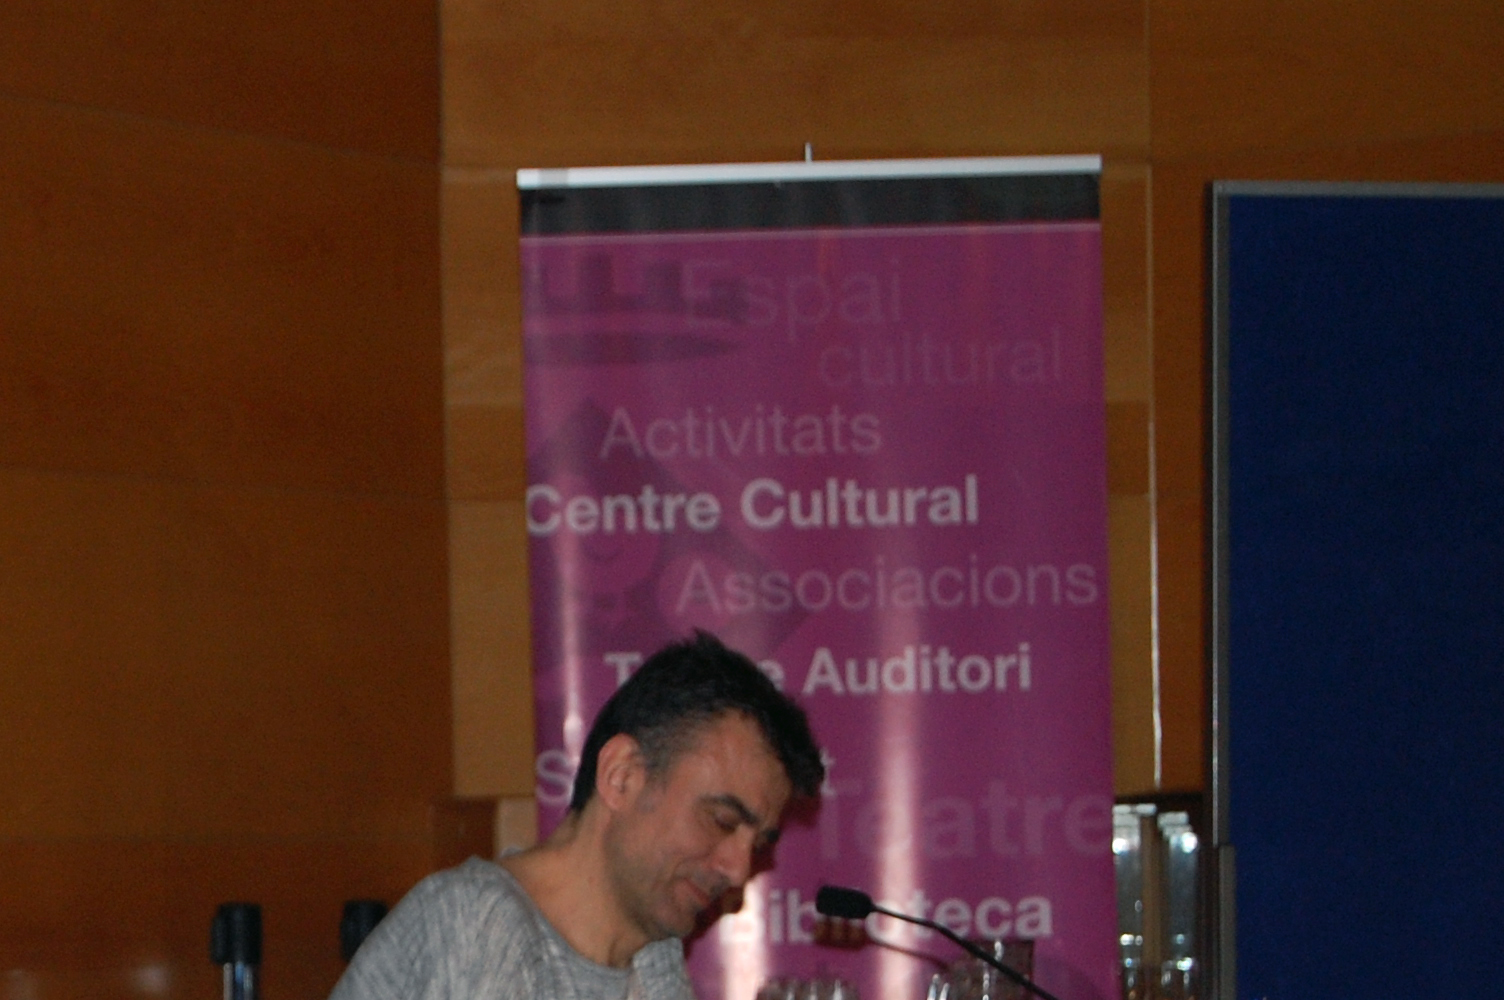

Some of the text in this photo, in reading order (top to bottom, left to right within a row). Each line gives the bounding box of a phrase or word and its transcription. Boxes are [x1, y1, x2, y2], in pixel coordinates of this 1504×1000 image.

[683, 257, 901, 340] Espai
[818, 327, 1062, 388] cultural
[600, 403, 883, 460] Activitats
[525, 473, 979, 535] Centre Cultural
[676, 552, 1098, 615] Associacions
[802, 643, 1033, 696] Auditori
